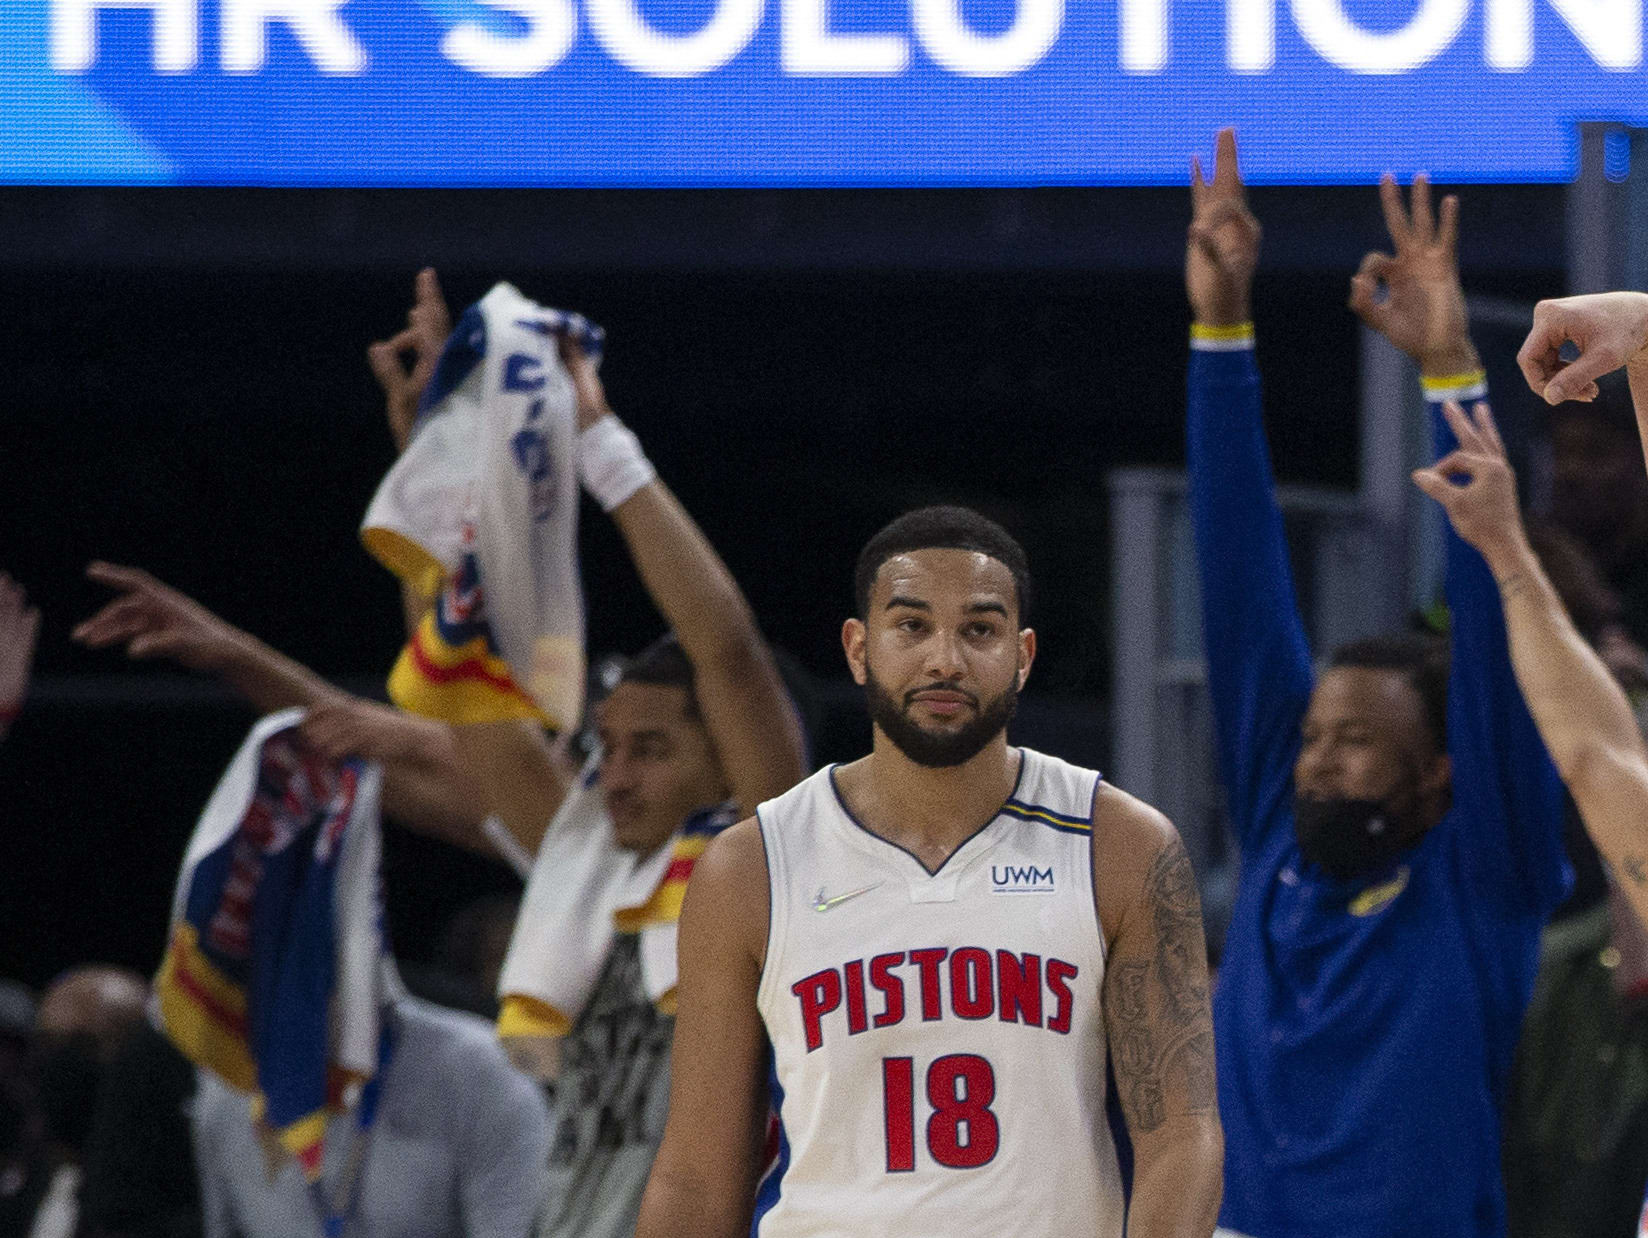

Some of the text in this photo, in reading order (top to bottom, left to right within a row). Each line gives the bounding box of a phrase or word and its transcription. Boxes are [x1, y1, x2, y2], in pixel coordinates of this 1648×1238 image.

[992, 865, 1055, 886] UWM
[791, 946, 1079, 1053] PISTONS
[882, 1053, 1000, 1174] 18
